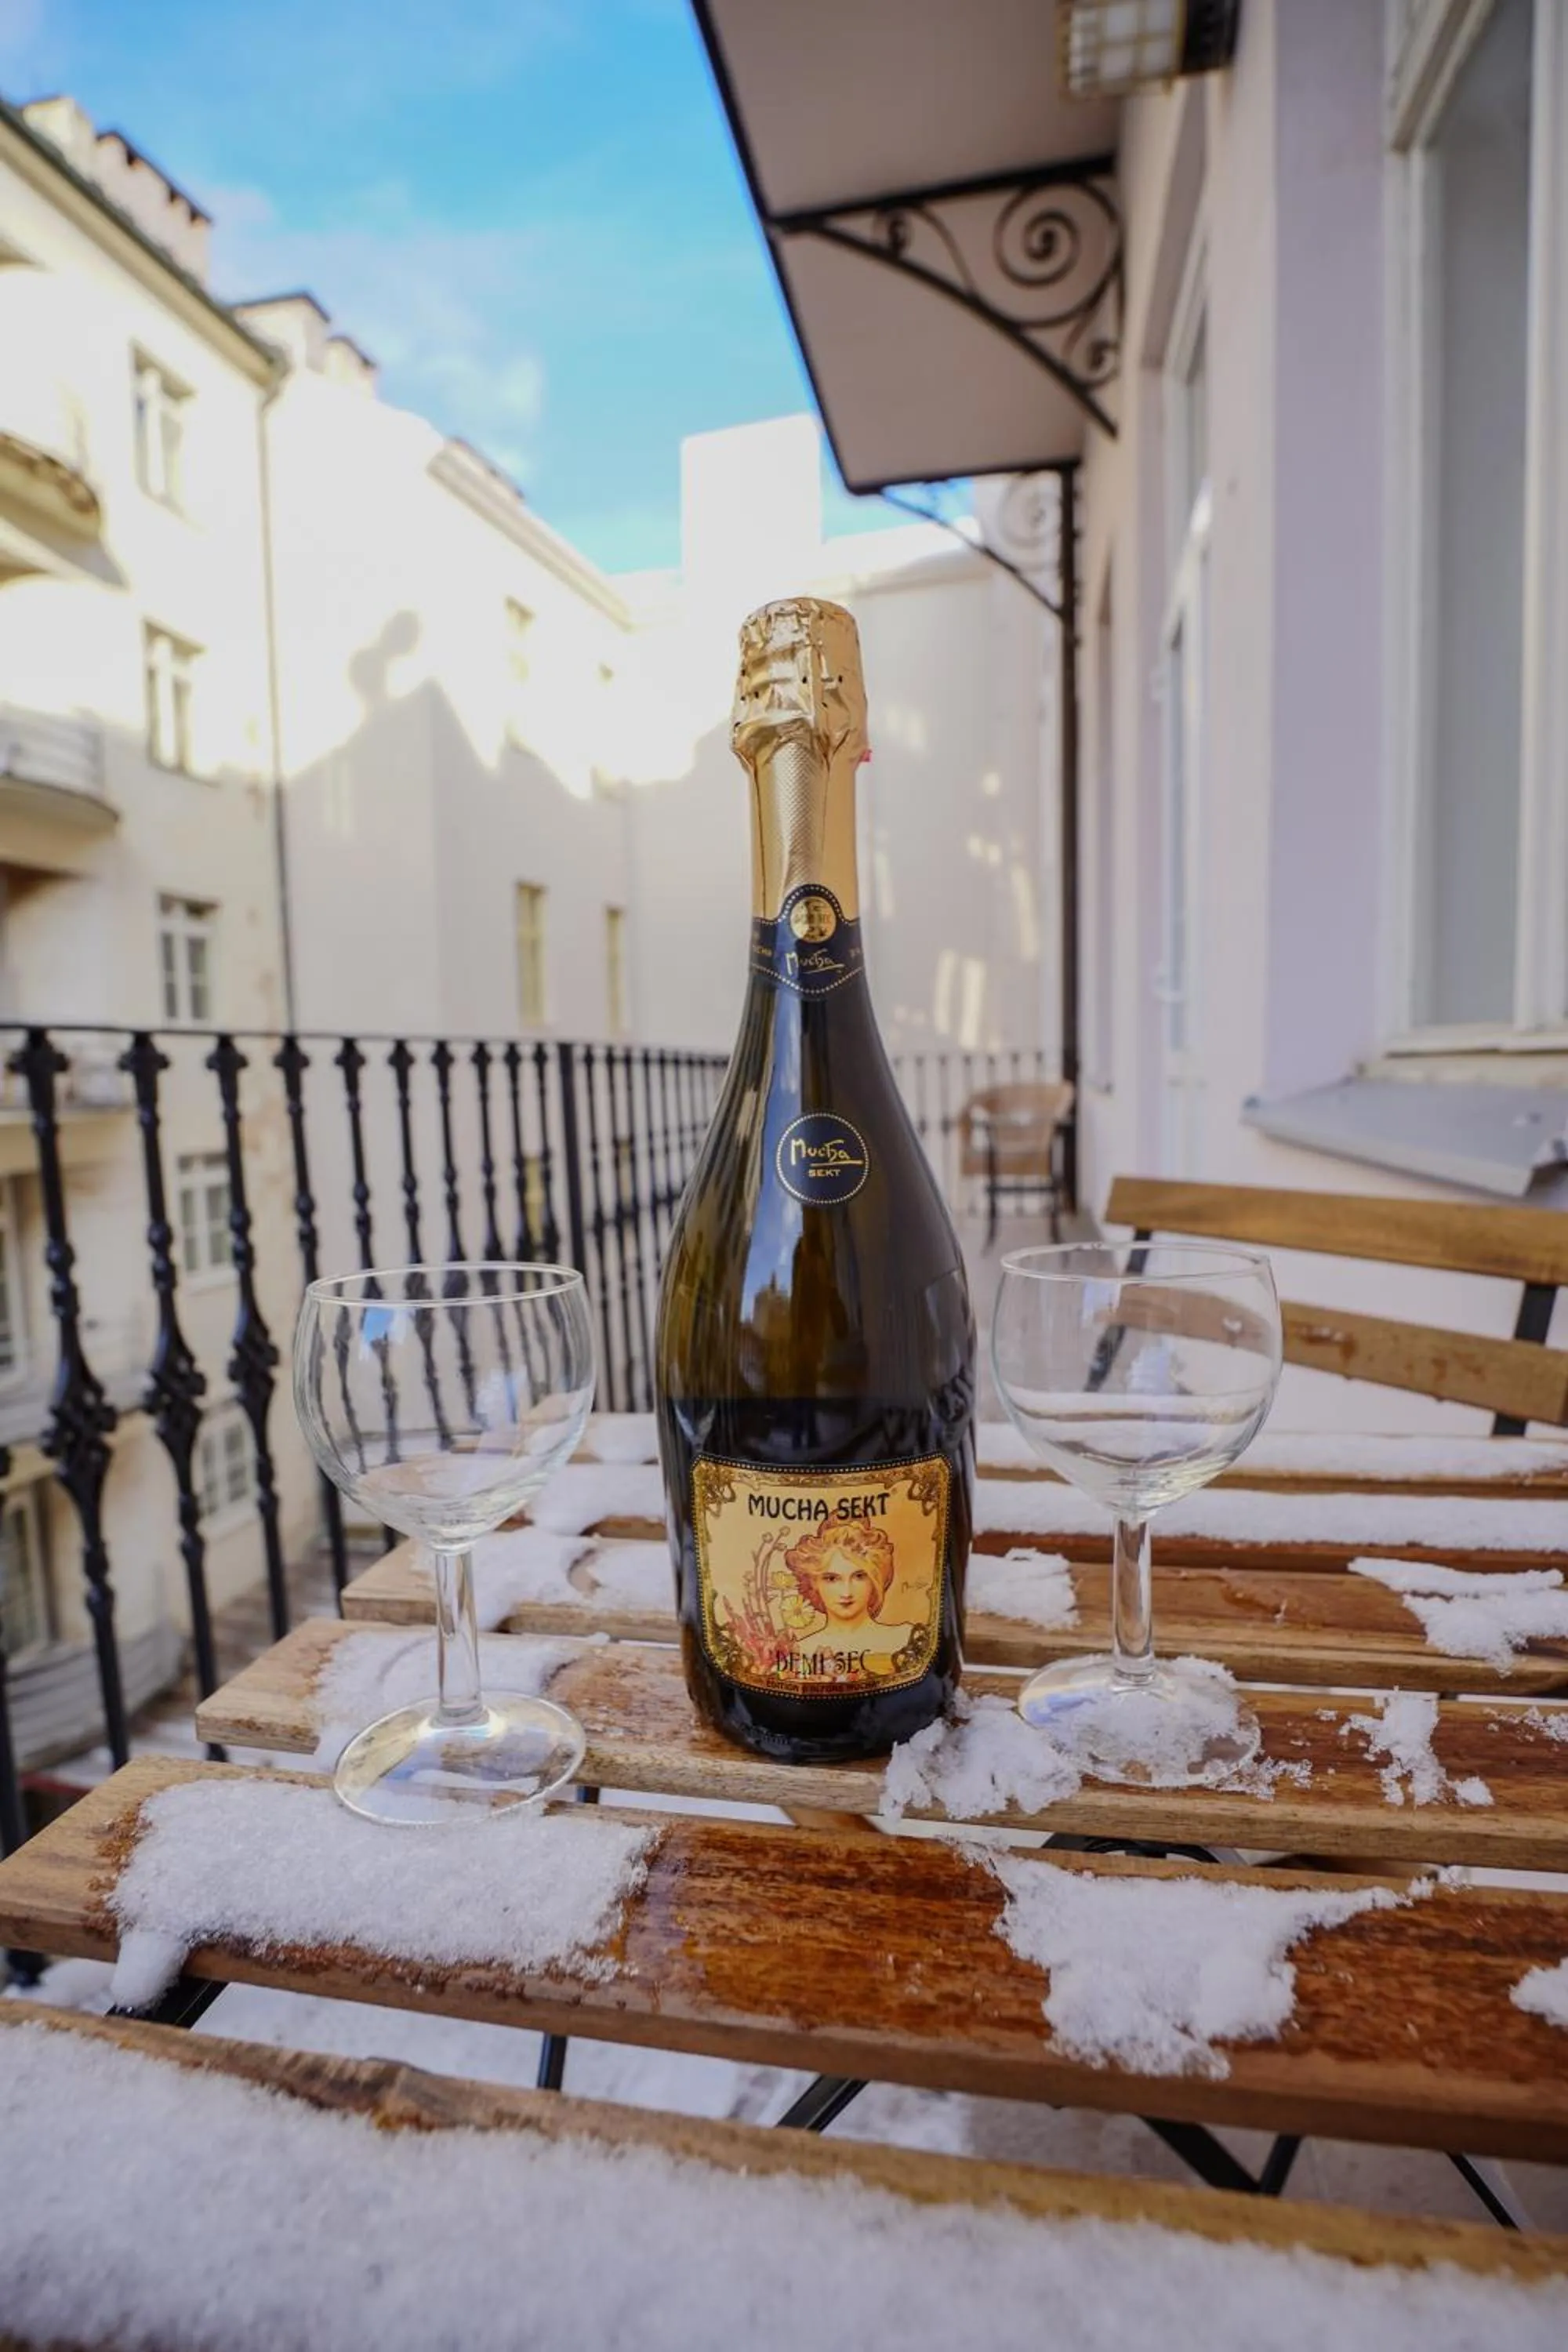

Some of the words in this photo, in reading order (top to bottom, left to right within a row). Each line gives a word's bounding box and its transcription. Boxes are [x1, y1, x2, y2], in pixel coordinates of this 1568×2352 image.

[785, 948, 837, 975] Mucha
[790, 1138, 852, 1166] Mucha
[808, 1169, 841, 1178] SEKT
[748, 1493, 829, 1521] MUCHA
[837, 1492, 890, 1520] SEKT
[834, 1649, 871, 1674] SEC
